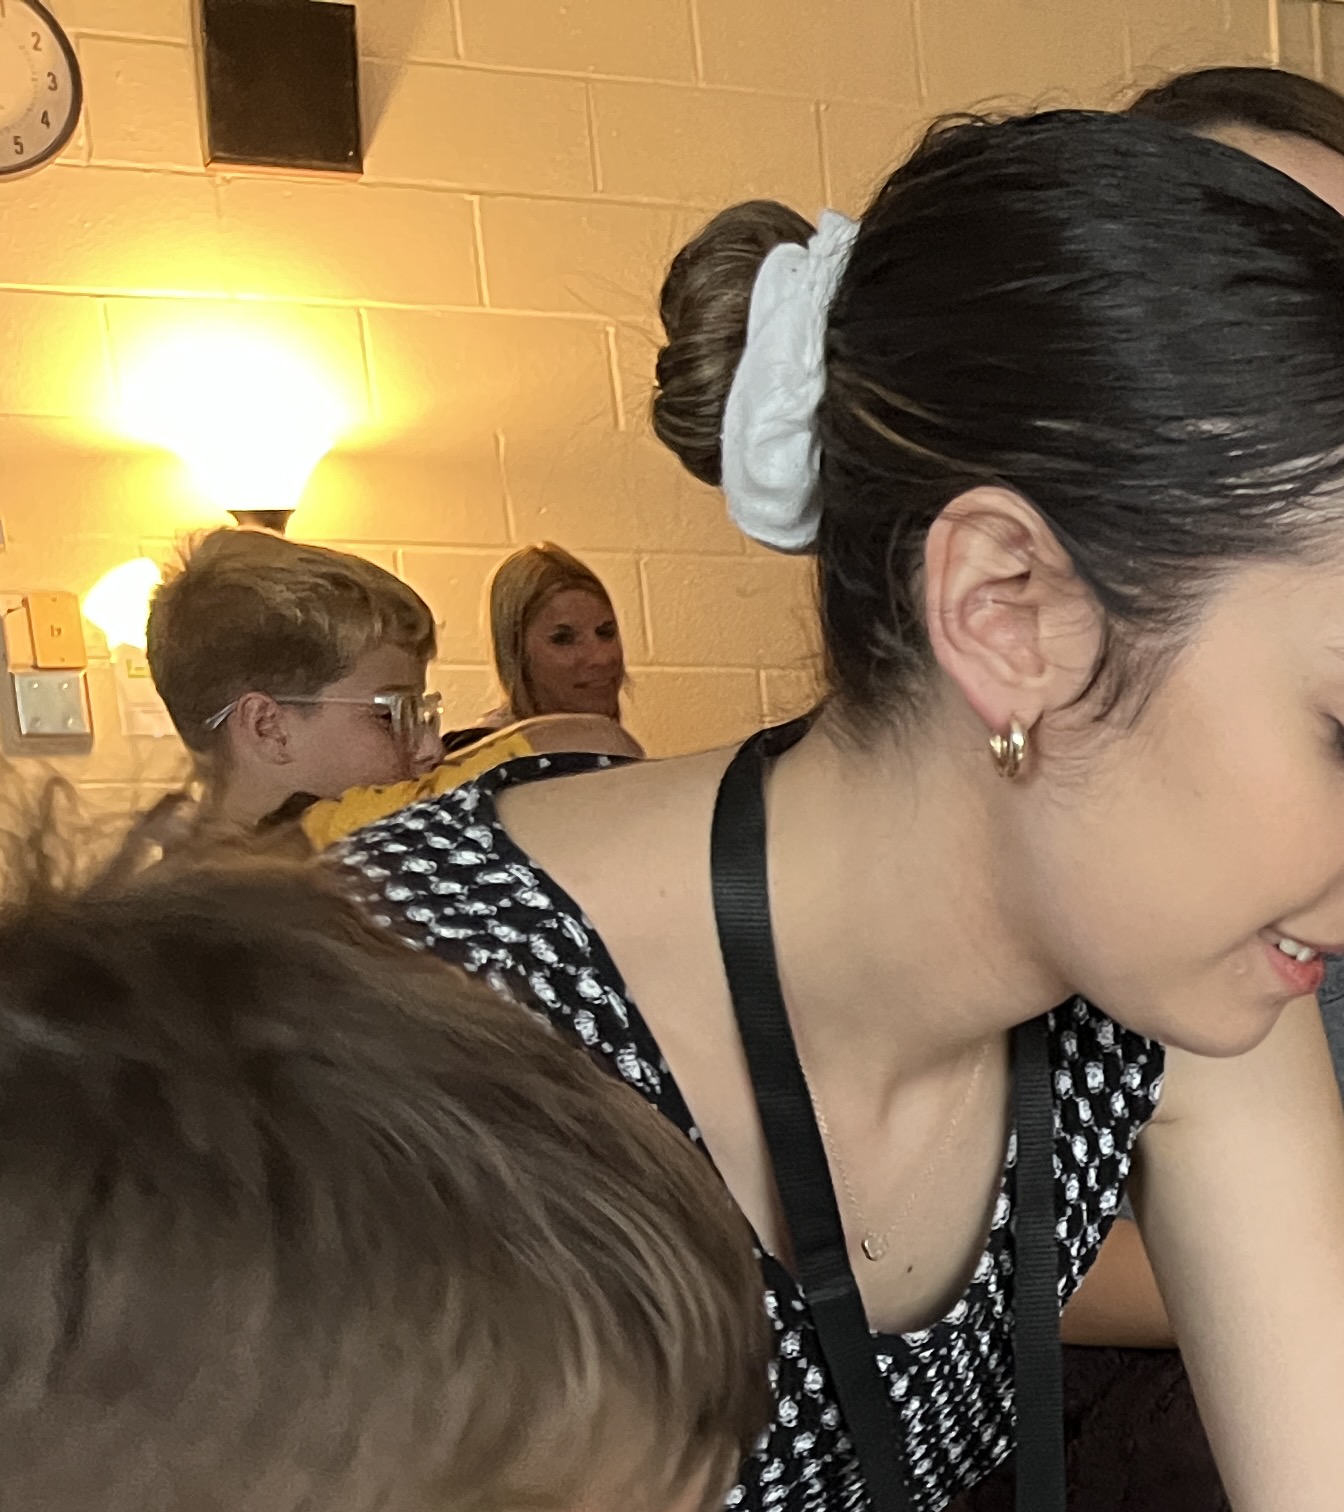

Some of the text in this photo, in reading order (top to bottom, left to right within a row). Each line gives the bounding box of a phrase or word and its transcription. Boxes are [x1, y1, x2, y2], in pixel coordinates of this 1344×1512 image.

[31, 31, 42, 51] 2
[47, 71, 58, 91] 3
[40, 109, 51, 129] 4
[13, 135, 24, 155] 5
